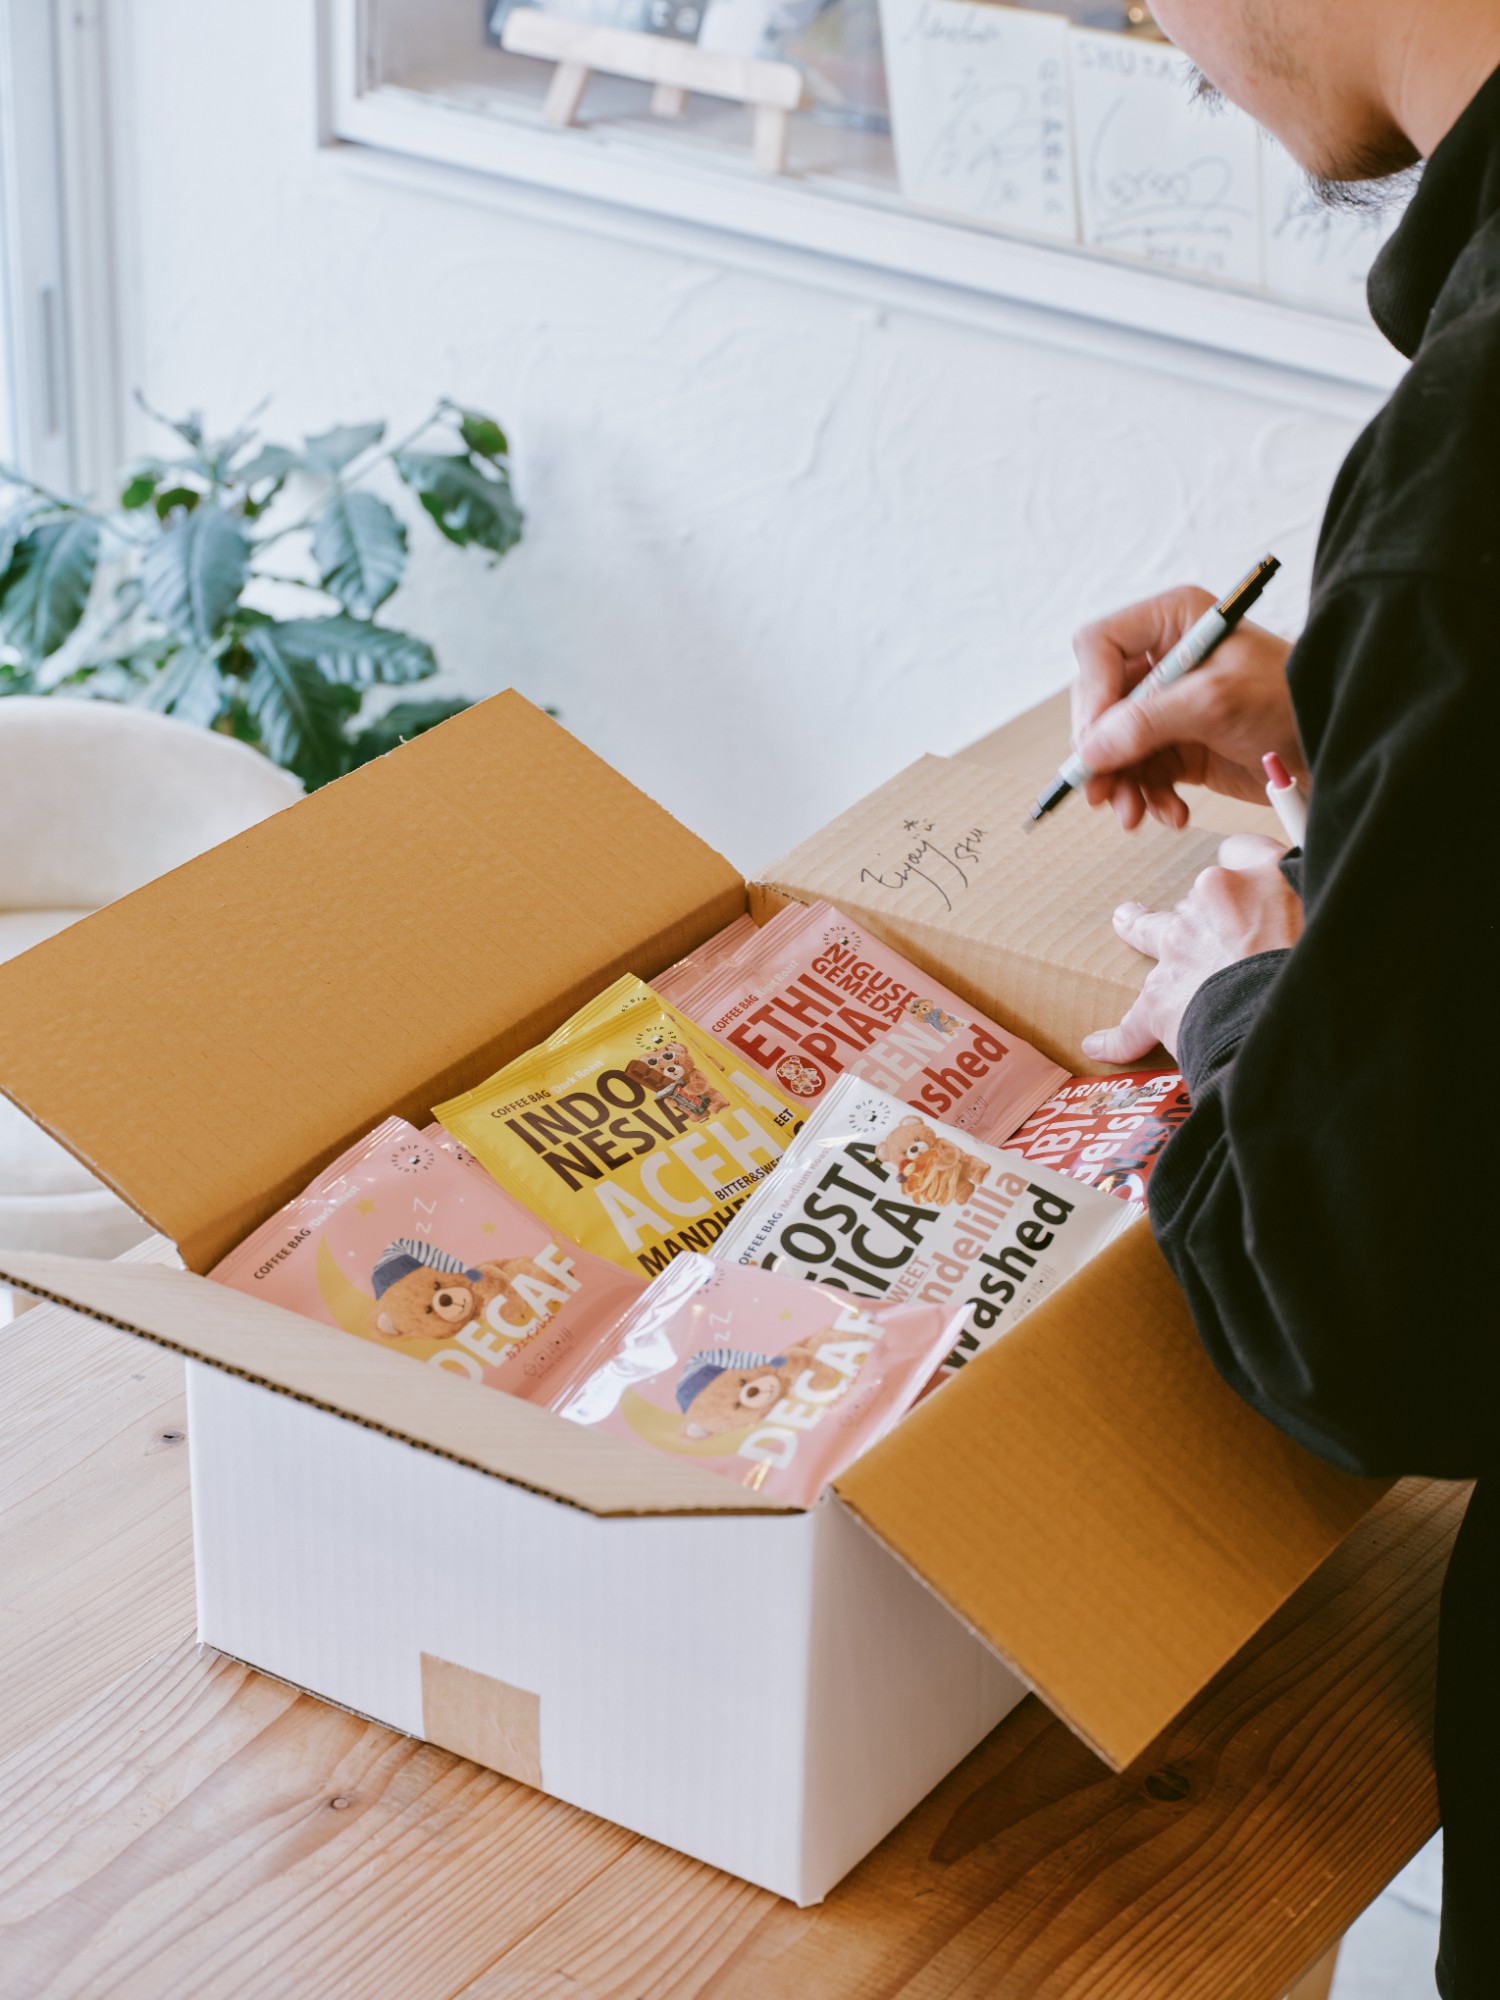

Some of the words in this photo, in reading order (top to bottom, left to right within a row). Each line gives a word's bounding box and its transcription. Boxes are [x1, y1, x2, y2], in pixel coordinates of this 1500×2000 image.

[711, 1006, 743, 1033] COFFEE
[740, 994, 759, 1011] BAG
[775, 959, 799, 984] Roast
[726, 973, 846, 1070] ETHI
[811, 957, 904, 1024] GEMEDA
[490, 1097, 530, 1119] COFFEE
[529, 1089, 552, 1104] BAG
[574, 1059, 605, 1080] Roast
[504, 1069, 646, 1155] INDO
[773, 1108, 794, 1127] EET
[1049, 1078, 1134, 1102] ARINO
[541, 1099, 690, 1192] NESIA
[714, 1154, 784, 1201] BITTER&SWE
[592, 1108, 788, 1254] ACEH
[253, 1247, 292, 1280] COFFEE
[287, 1228, 311, 1250] BAG
[738, 1233, 767, 1266] OFFEE
[761, 1212, 783, 1233] BAG
[805, 1198, 941, 1299] ICA
[917, 1171, 1029, 1304] ndelilla
[427, 1243, 583, 1385] DECAF
[885, 1255, 930, 1304] WEET
[505, 1312, 556, 1361] カフェインレス
[737, 1307, 886, 1471] DECAF
